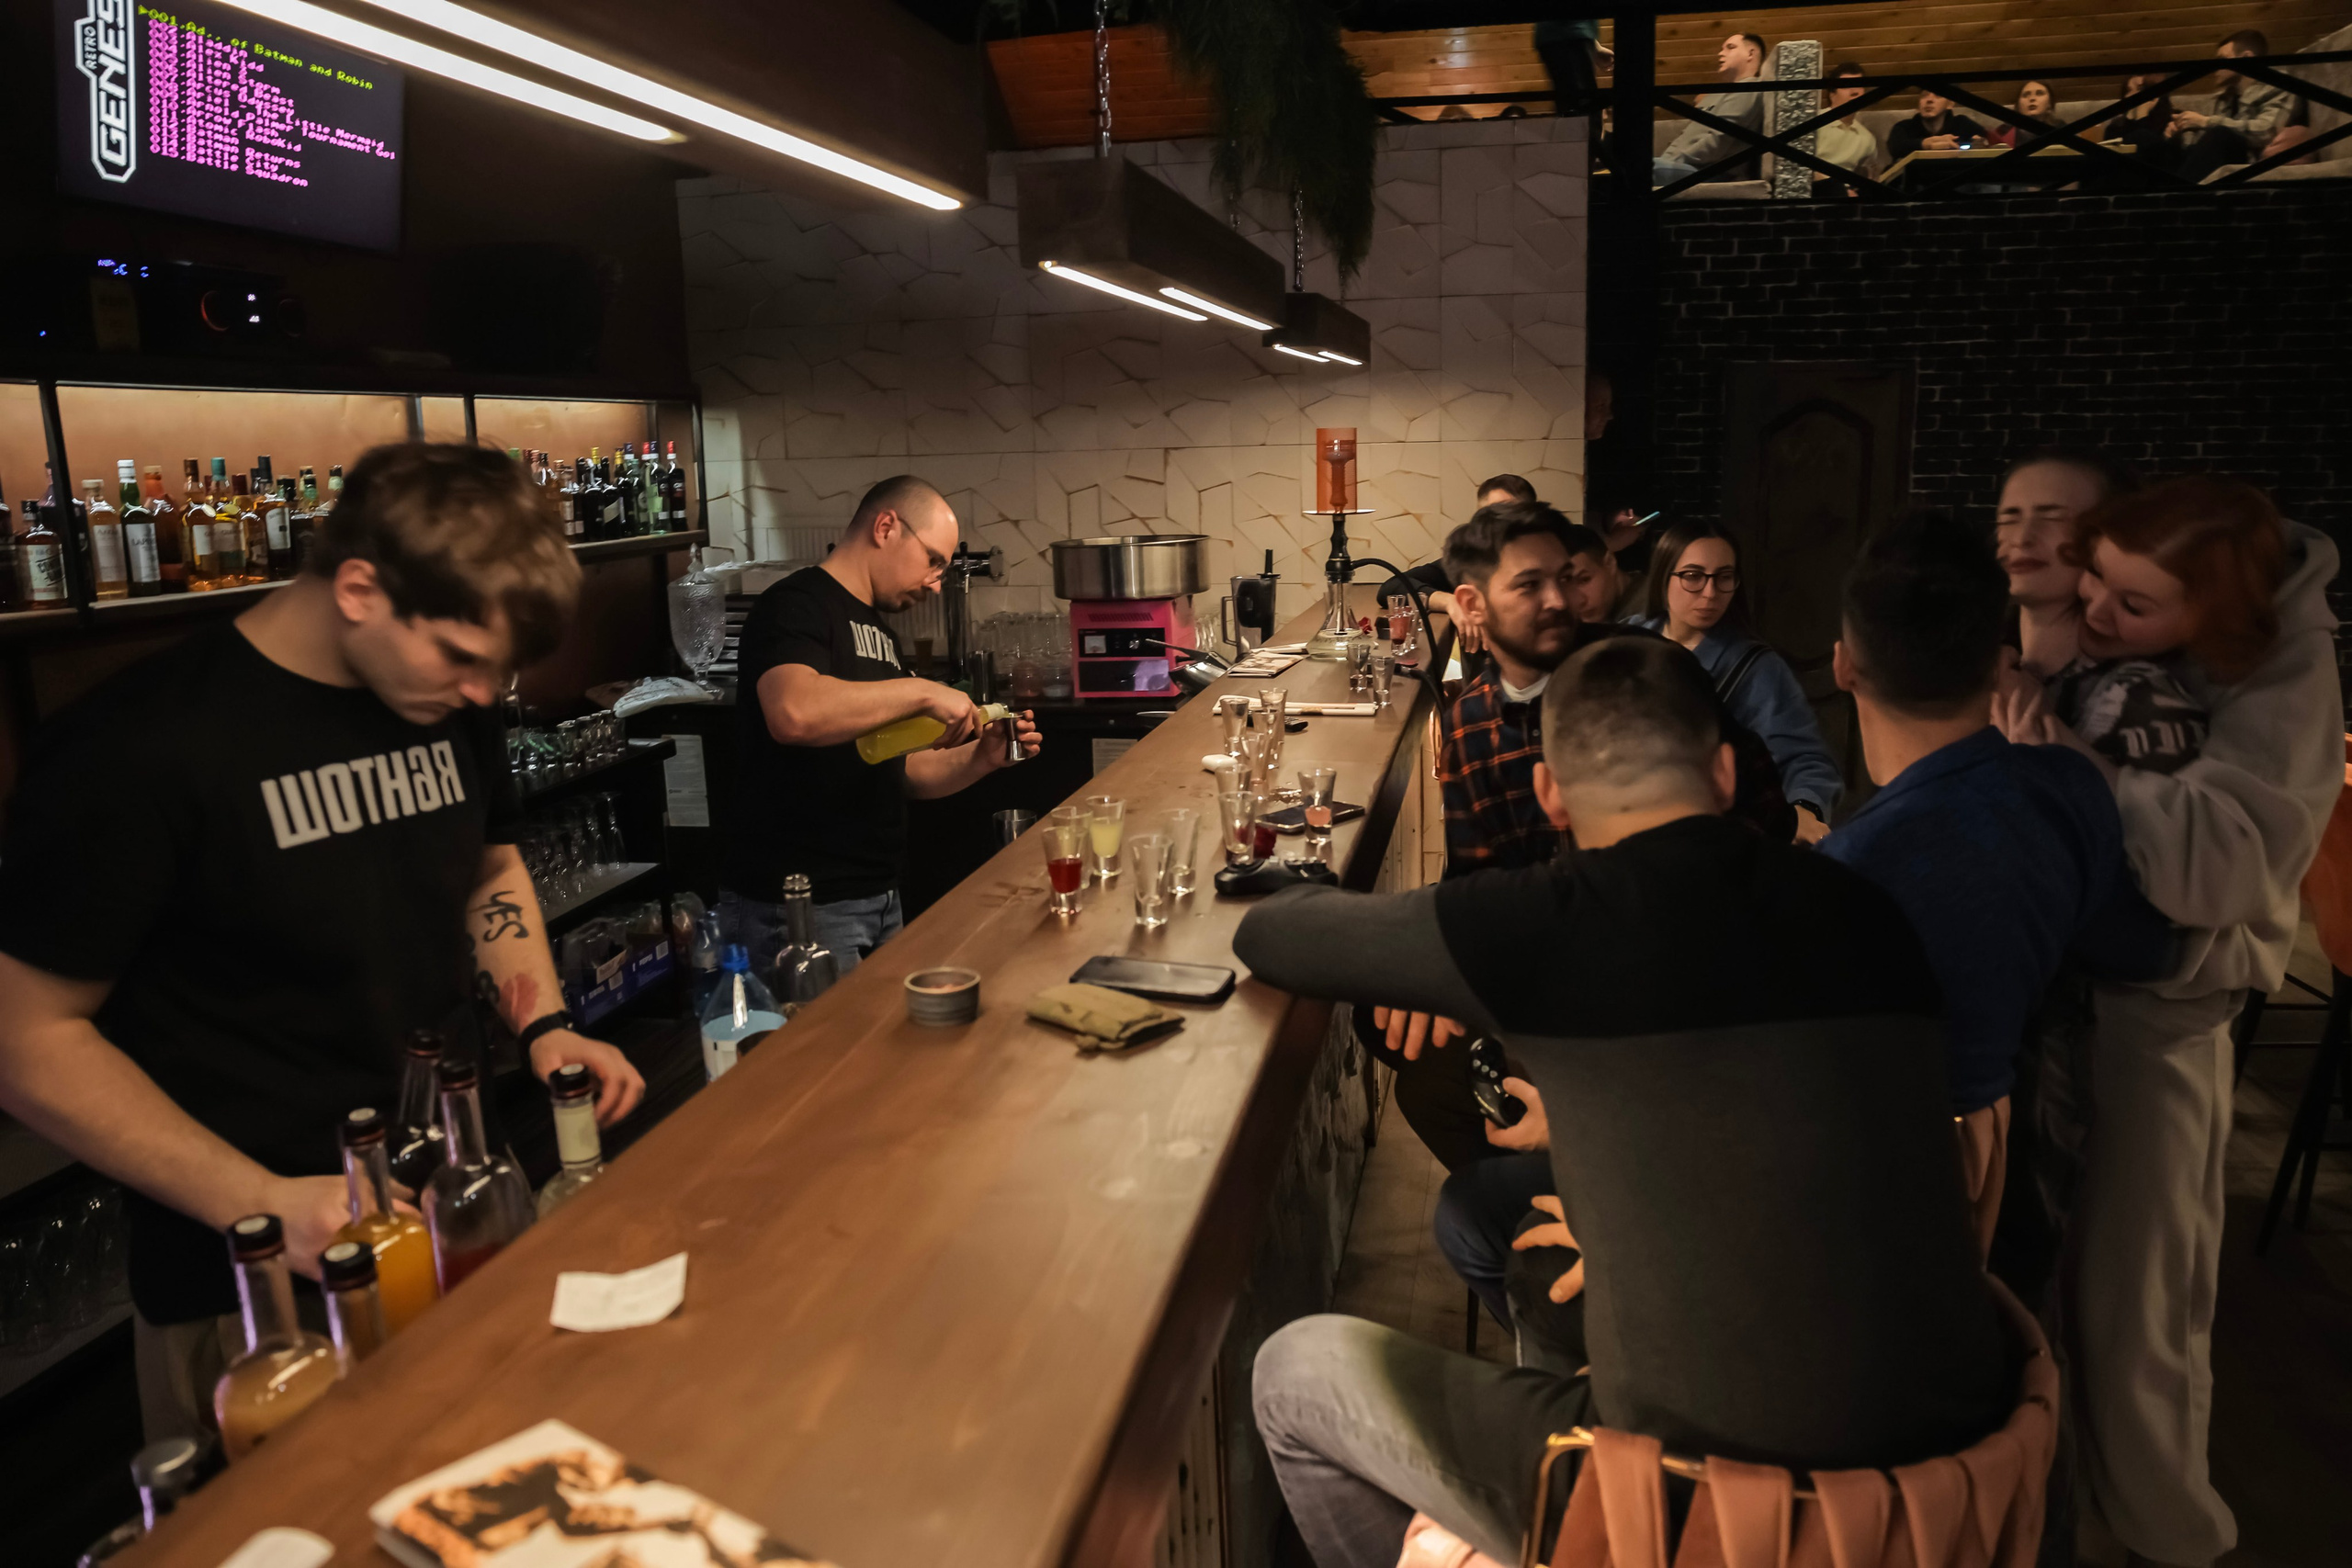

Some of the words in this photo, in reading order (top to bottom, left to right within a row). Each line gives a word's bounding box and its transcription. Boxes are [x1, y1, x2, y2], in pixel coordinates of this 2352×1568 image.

[84, 26, 97, 70] RETRO
[229, 53, 264, 72] Kidd
[231, 39, 247, 48] of
[254, 43, 302, 66] Batman
[310, 64, 332, 76] and
[336, 71, 372, 89] Robin
[238, 74, 280, 95] Storm
[254, 88, 293, 107] Beast
[237, 119, 278, 137] Flash
[244, 112, 293, 131] Palmer
[254, 106, 279, 119] The
[286, 114, 330, 133] Little
[335, 129, 383, 149] Mermaid
[244, 148, 300, 167] Returns
[245, 157, 278, 172] City
[245, 165, 307, 186] Squadron
